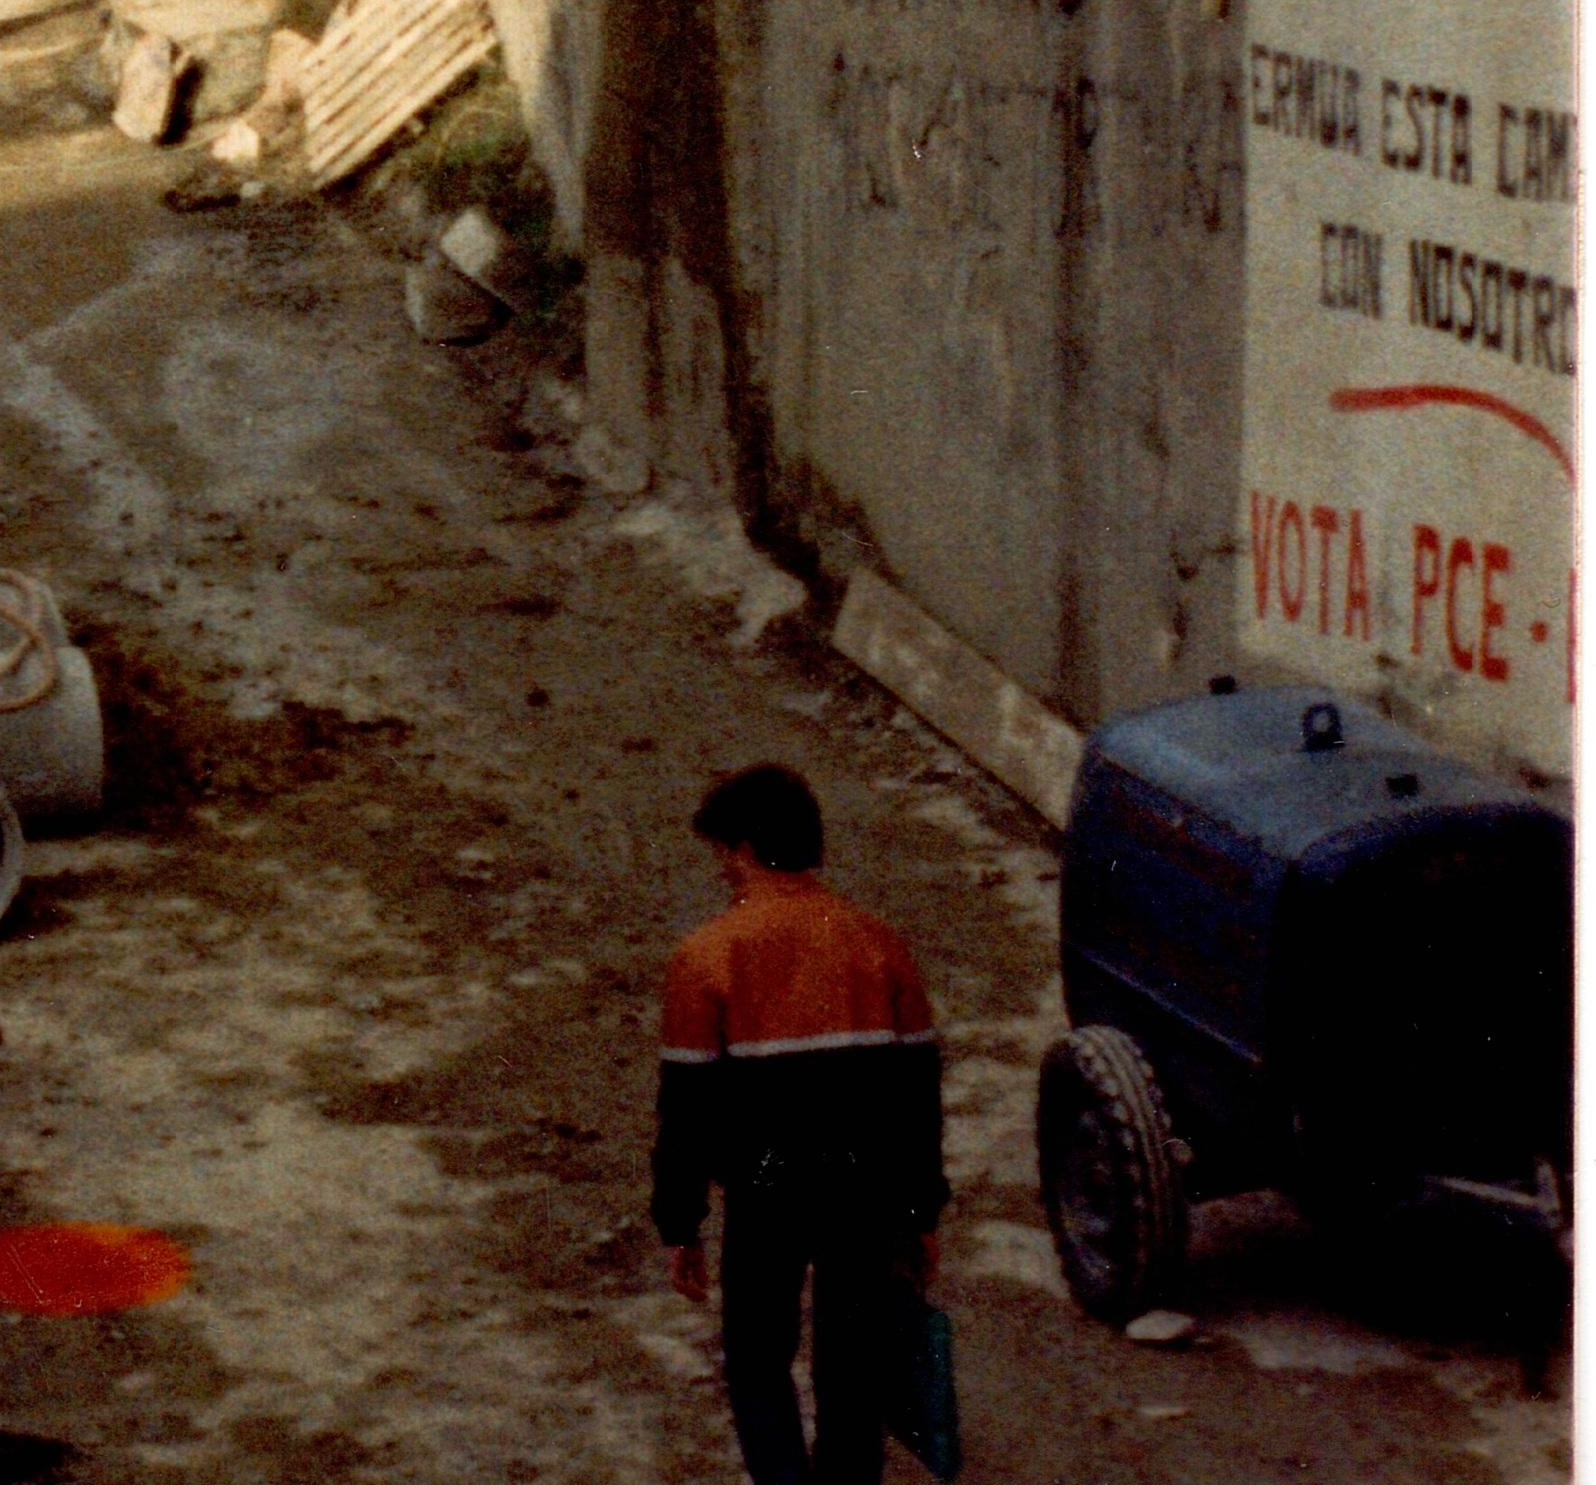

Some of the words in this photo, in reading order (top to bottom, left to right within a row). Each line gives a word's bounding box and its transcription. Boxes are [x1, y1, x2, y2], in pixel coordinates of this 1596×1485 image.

[1251, 43, 1362, 157] ERMUA
[1381, 78, 1472, 185] ESTA
[1497, 101, 1576, 204] CAM
[1319, 221, 1383, 321] CON
[1251, 490, 1371, 642] VOTA
